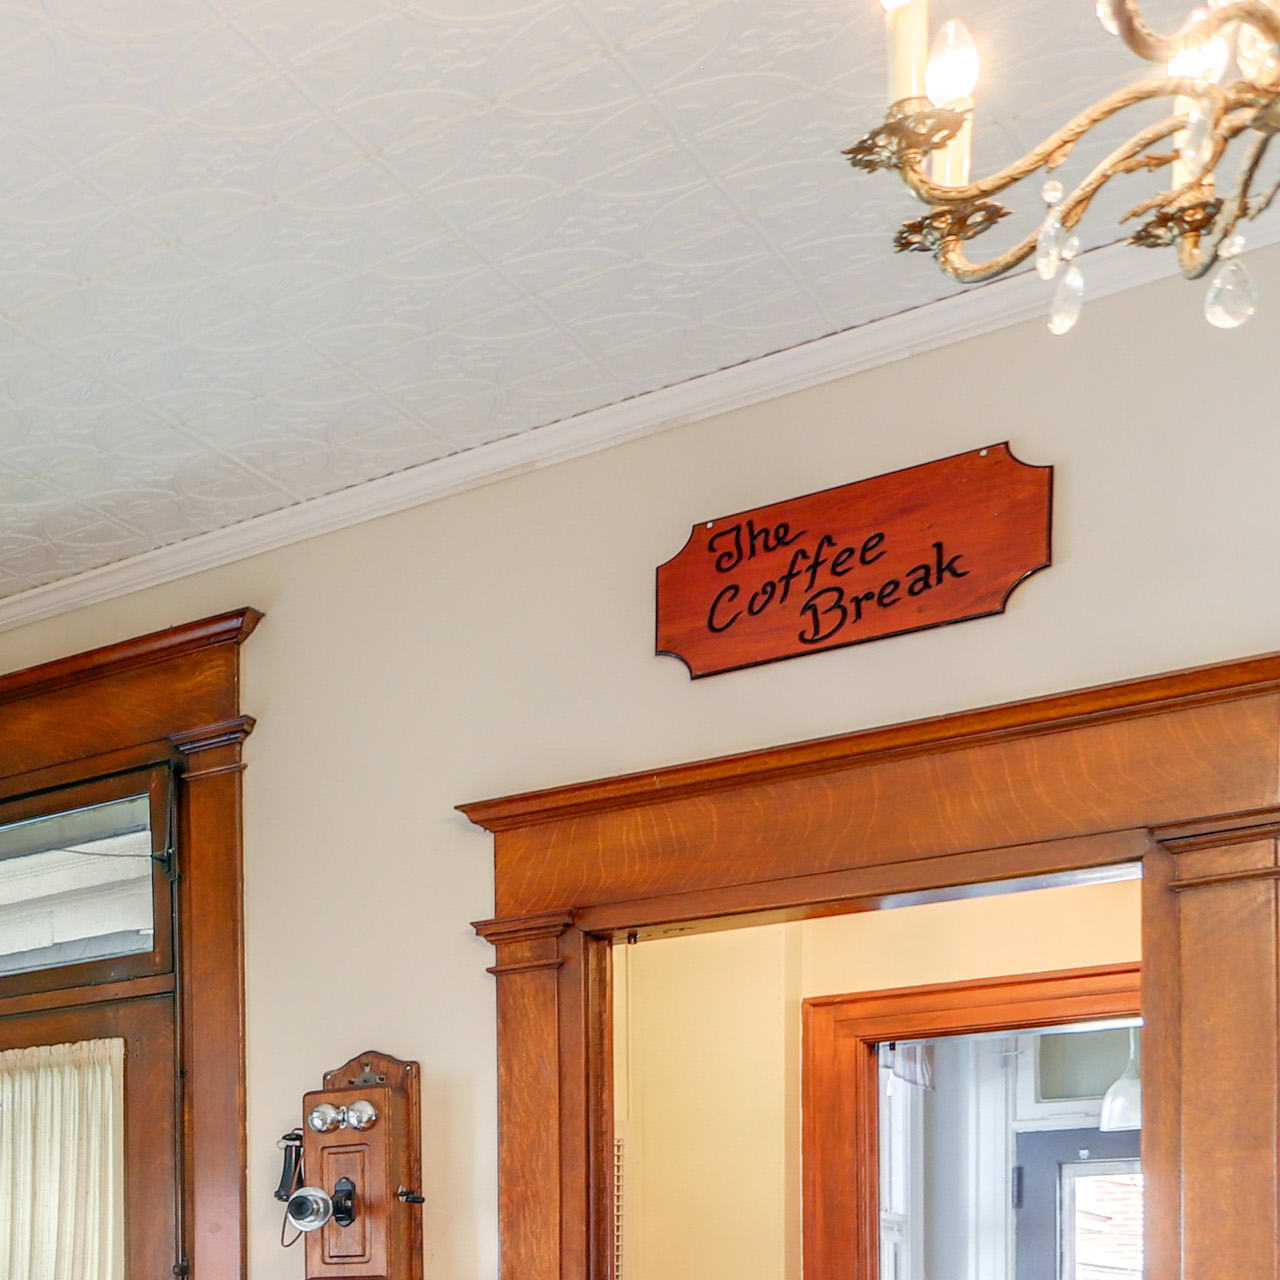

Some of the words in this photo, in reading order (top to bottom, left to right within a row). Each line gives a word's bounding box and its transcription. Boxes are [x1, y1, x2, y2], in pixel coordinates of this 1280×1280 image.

[707, 531, 886, 633] Coffee
[708, 519, 807, 573] The
[798, 541, 969, 644] Break
